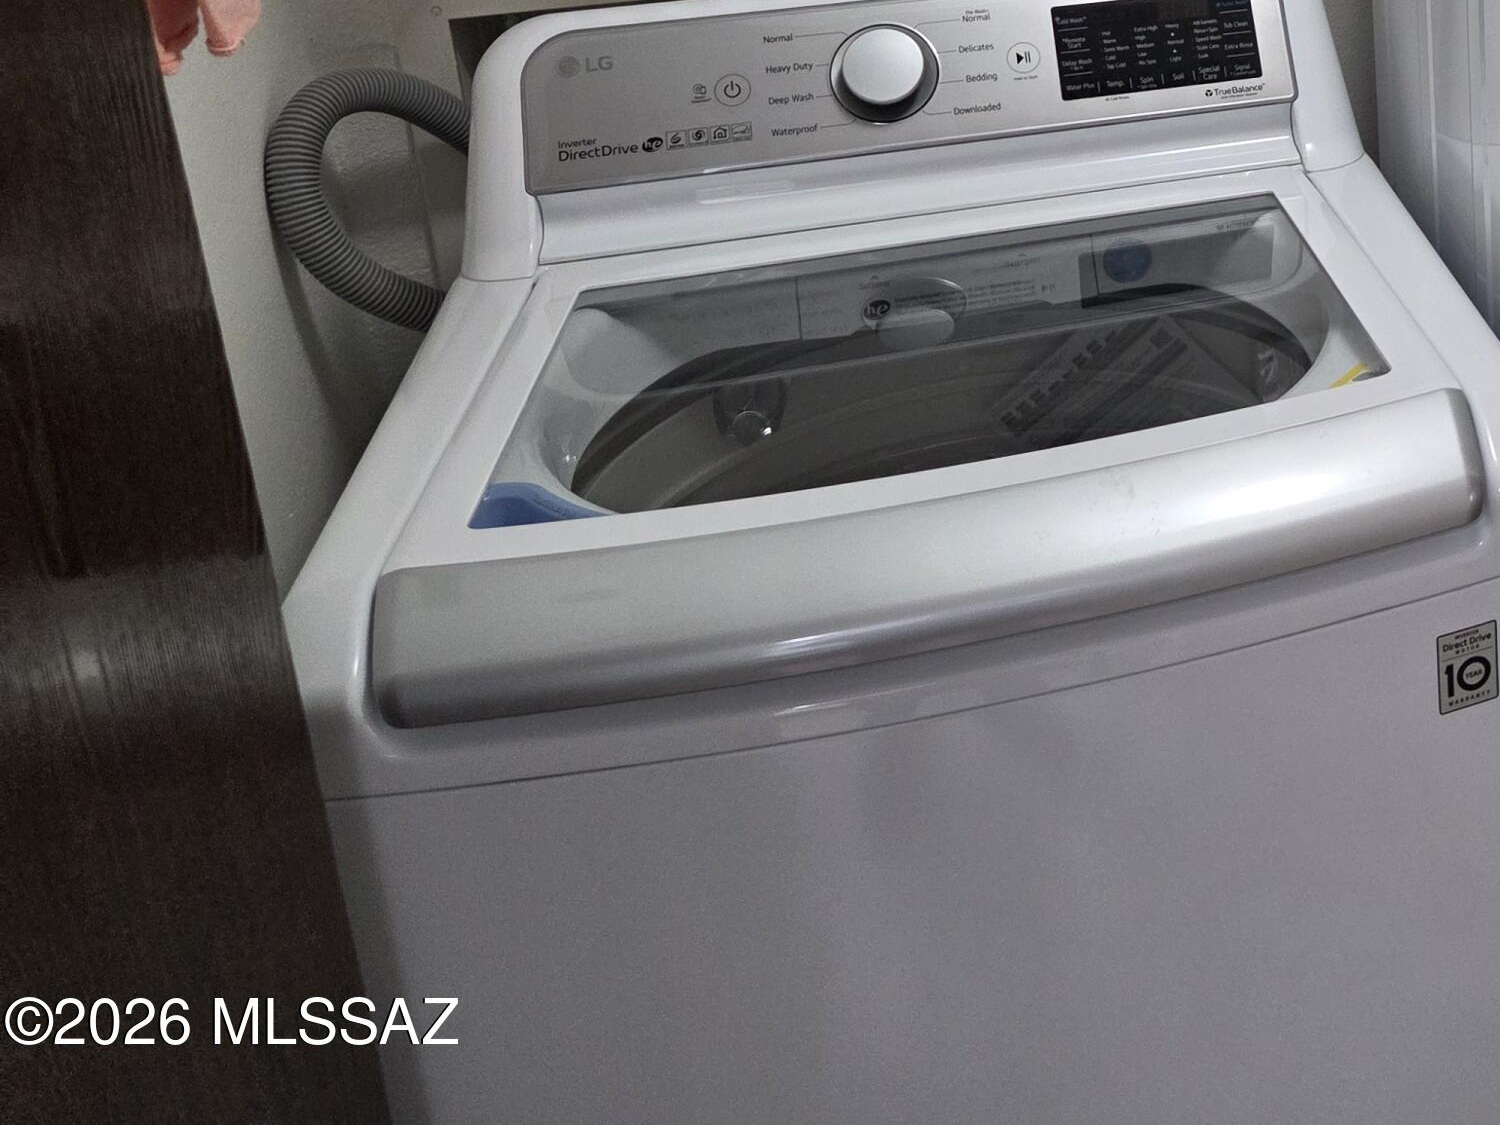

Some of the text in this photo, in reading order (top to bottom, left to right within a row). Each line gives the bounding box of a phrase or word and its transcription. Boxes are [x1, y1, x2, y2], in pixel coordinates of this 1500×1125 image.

[962, 13, 991, 23] Normal
[763, 33, 794, 43] Normal
[958, 43, 994, 54] Delicates
[585, 56, 614, 73] LG
[765, 62, 813, 74] Heavy Duty
[1198, 65, 1220, 74] Special
[966, 73, 998, 83] Bedding
[1172, 73, 1184, 81] Soil
[1203, 73, 1217, 81] Care
[768, 92, 814, 106] Deep Wash
[953, 102, 1002, 116] Downloaded
[771, 123, 818, 137] Waterproof
[558, 138, 597, 149] Inverter
[558, 144, 639, 162] DirectDrive
[1442, 632, 1492, 653] Direct Drive
[1444, 656, 1491, 699] 10
[1465, 668, 1483, 679] YEAR
[1448, 689, 1491, 707] WARRANTY
